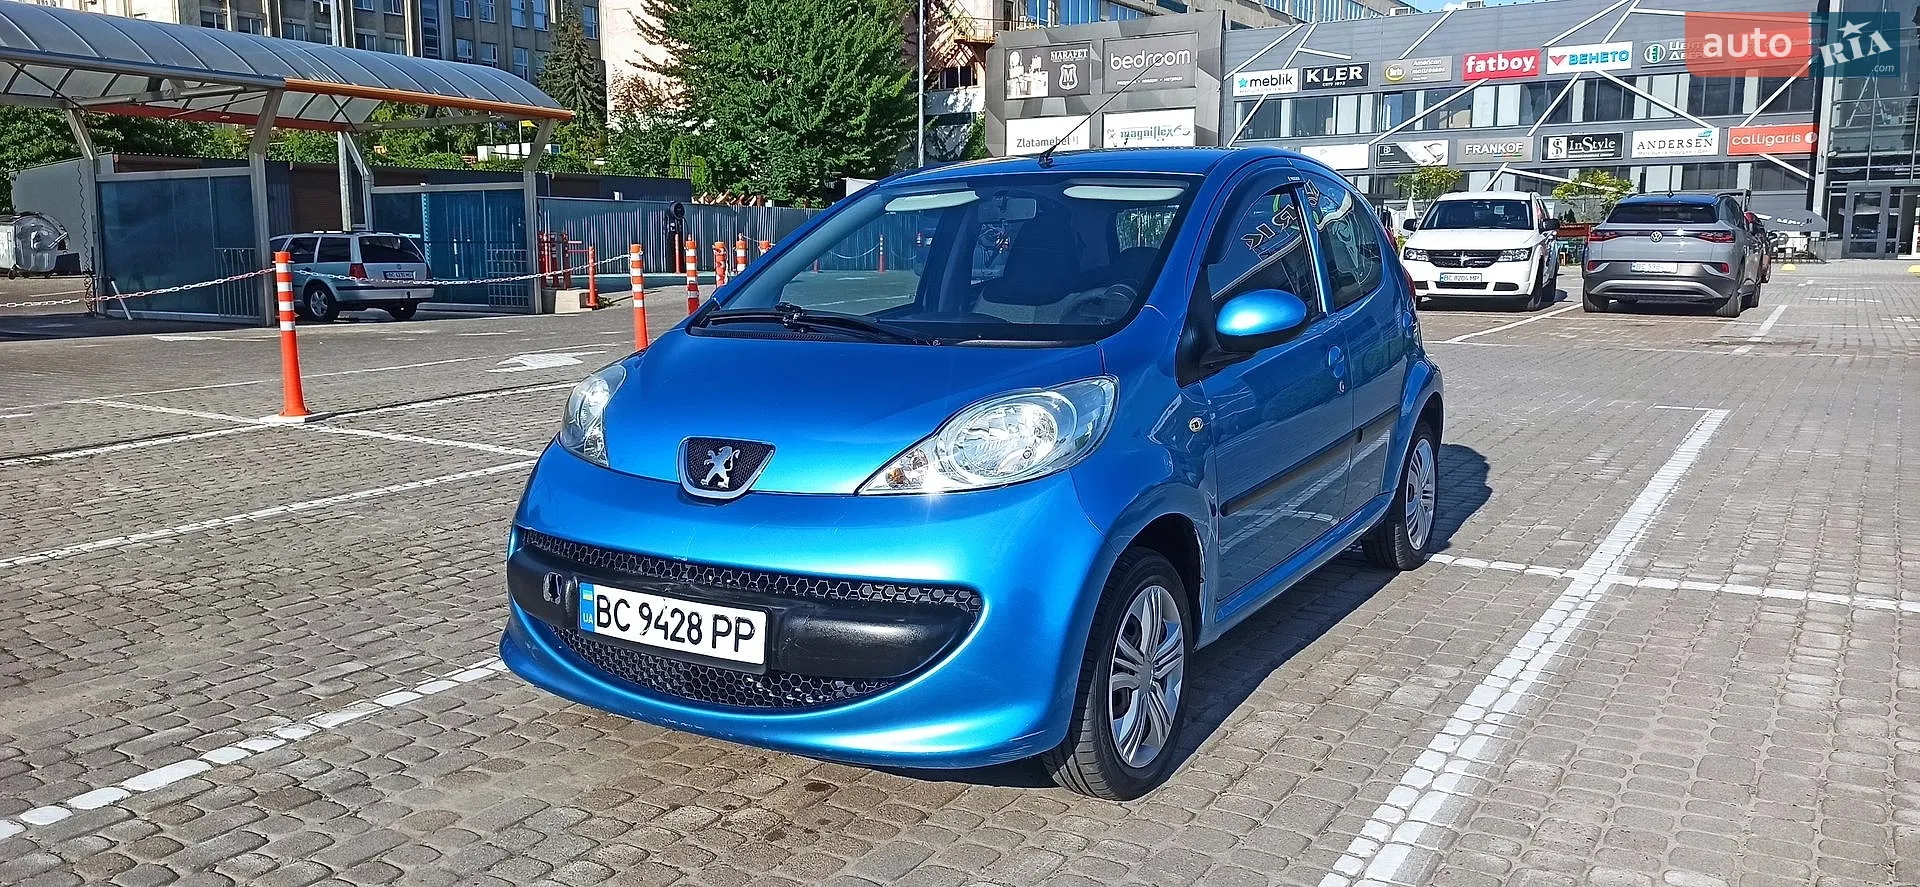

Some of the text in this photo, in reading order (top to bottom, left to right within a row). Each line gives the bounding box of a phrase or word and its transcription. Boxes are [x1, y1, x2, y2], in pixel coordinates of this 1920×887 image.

[1050, 48, 1089, 60] MARAFET
[1109, 49, 1191, 71] bedroom
[1249, 74, 1293, 88] meblik
[1306, 66, 1363, 83] KLER
[1120, 124, 1174, 141] magniflex
[1731, 132, 1802, 148] calligaris
[1016, 135, 1071, 149] Zlatamebel
[1465, 142, 1524, 156] FRANKOF
[1567, 136, 1616, 152] InStyle
[1636, 137, 1714, 151] ANDERSEN
[583, 613, 594, 624] UA
[596, 594, 756, 653] BC 9428 PP
